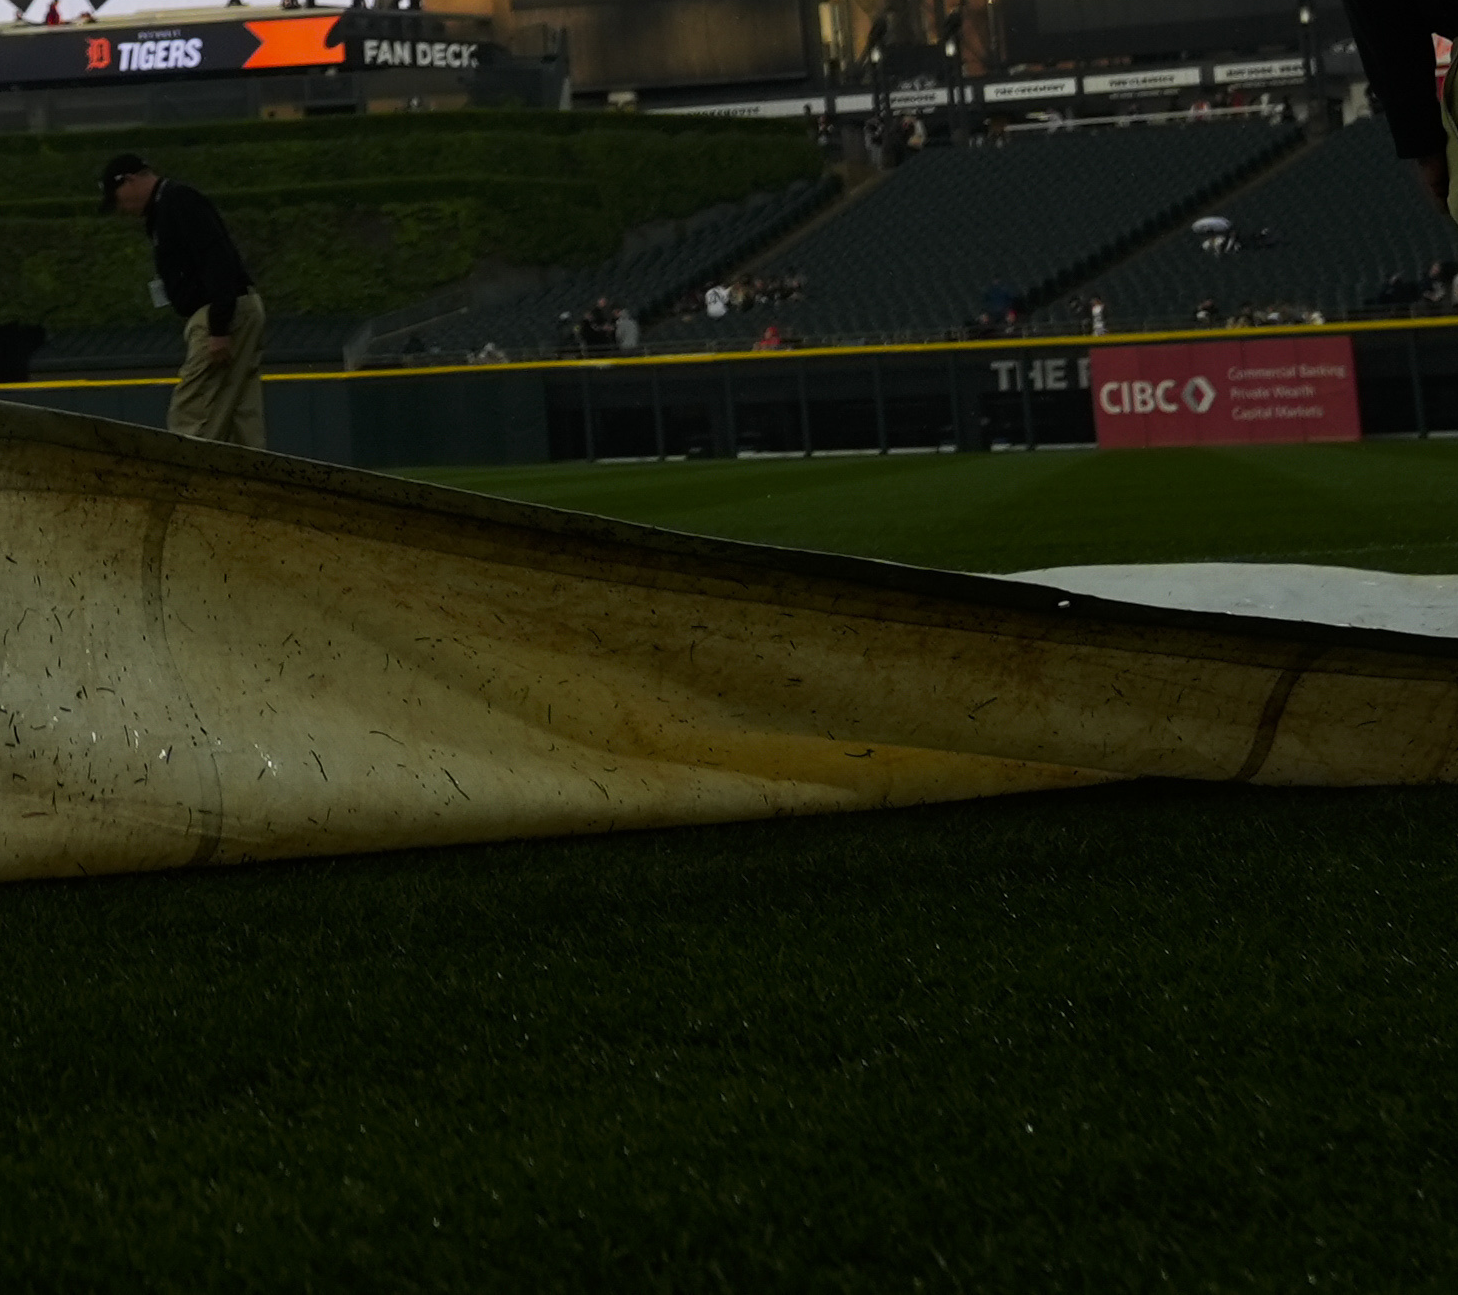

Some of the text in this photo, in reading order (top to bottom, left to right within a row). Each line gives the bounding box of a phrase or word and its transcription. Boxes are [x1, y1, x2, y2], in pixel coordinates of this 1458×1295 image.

[117, 37, 203, 72] TIGERS
[363, 38, 479, 69] FAN DECK
[990, 357, 1067, 392] THE
[1099, 378, 1179, 415] CIBC
